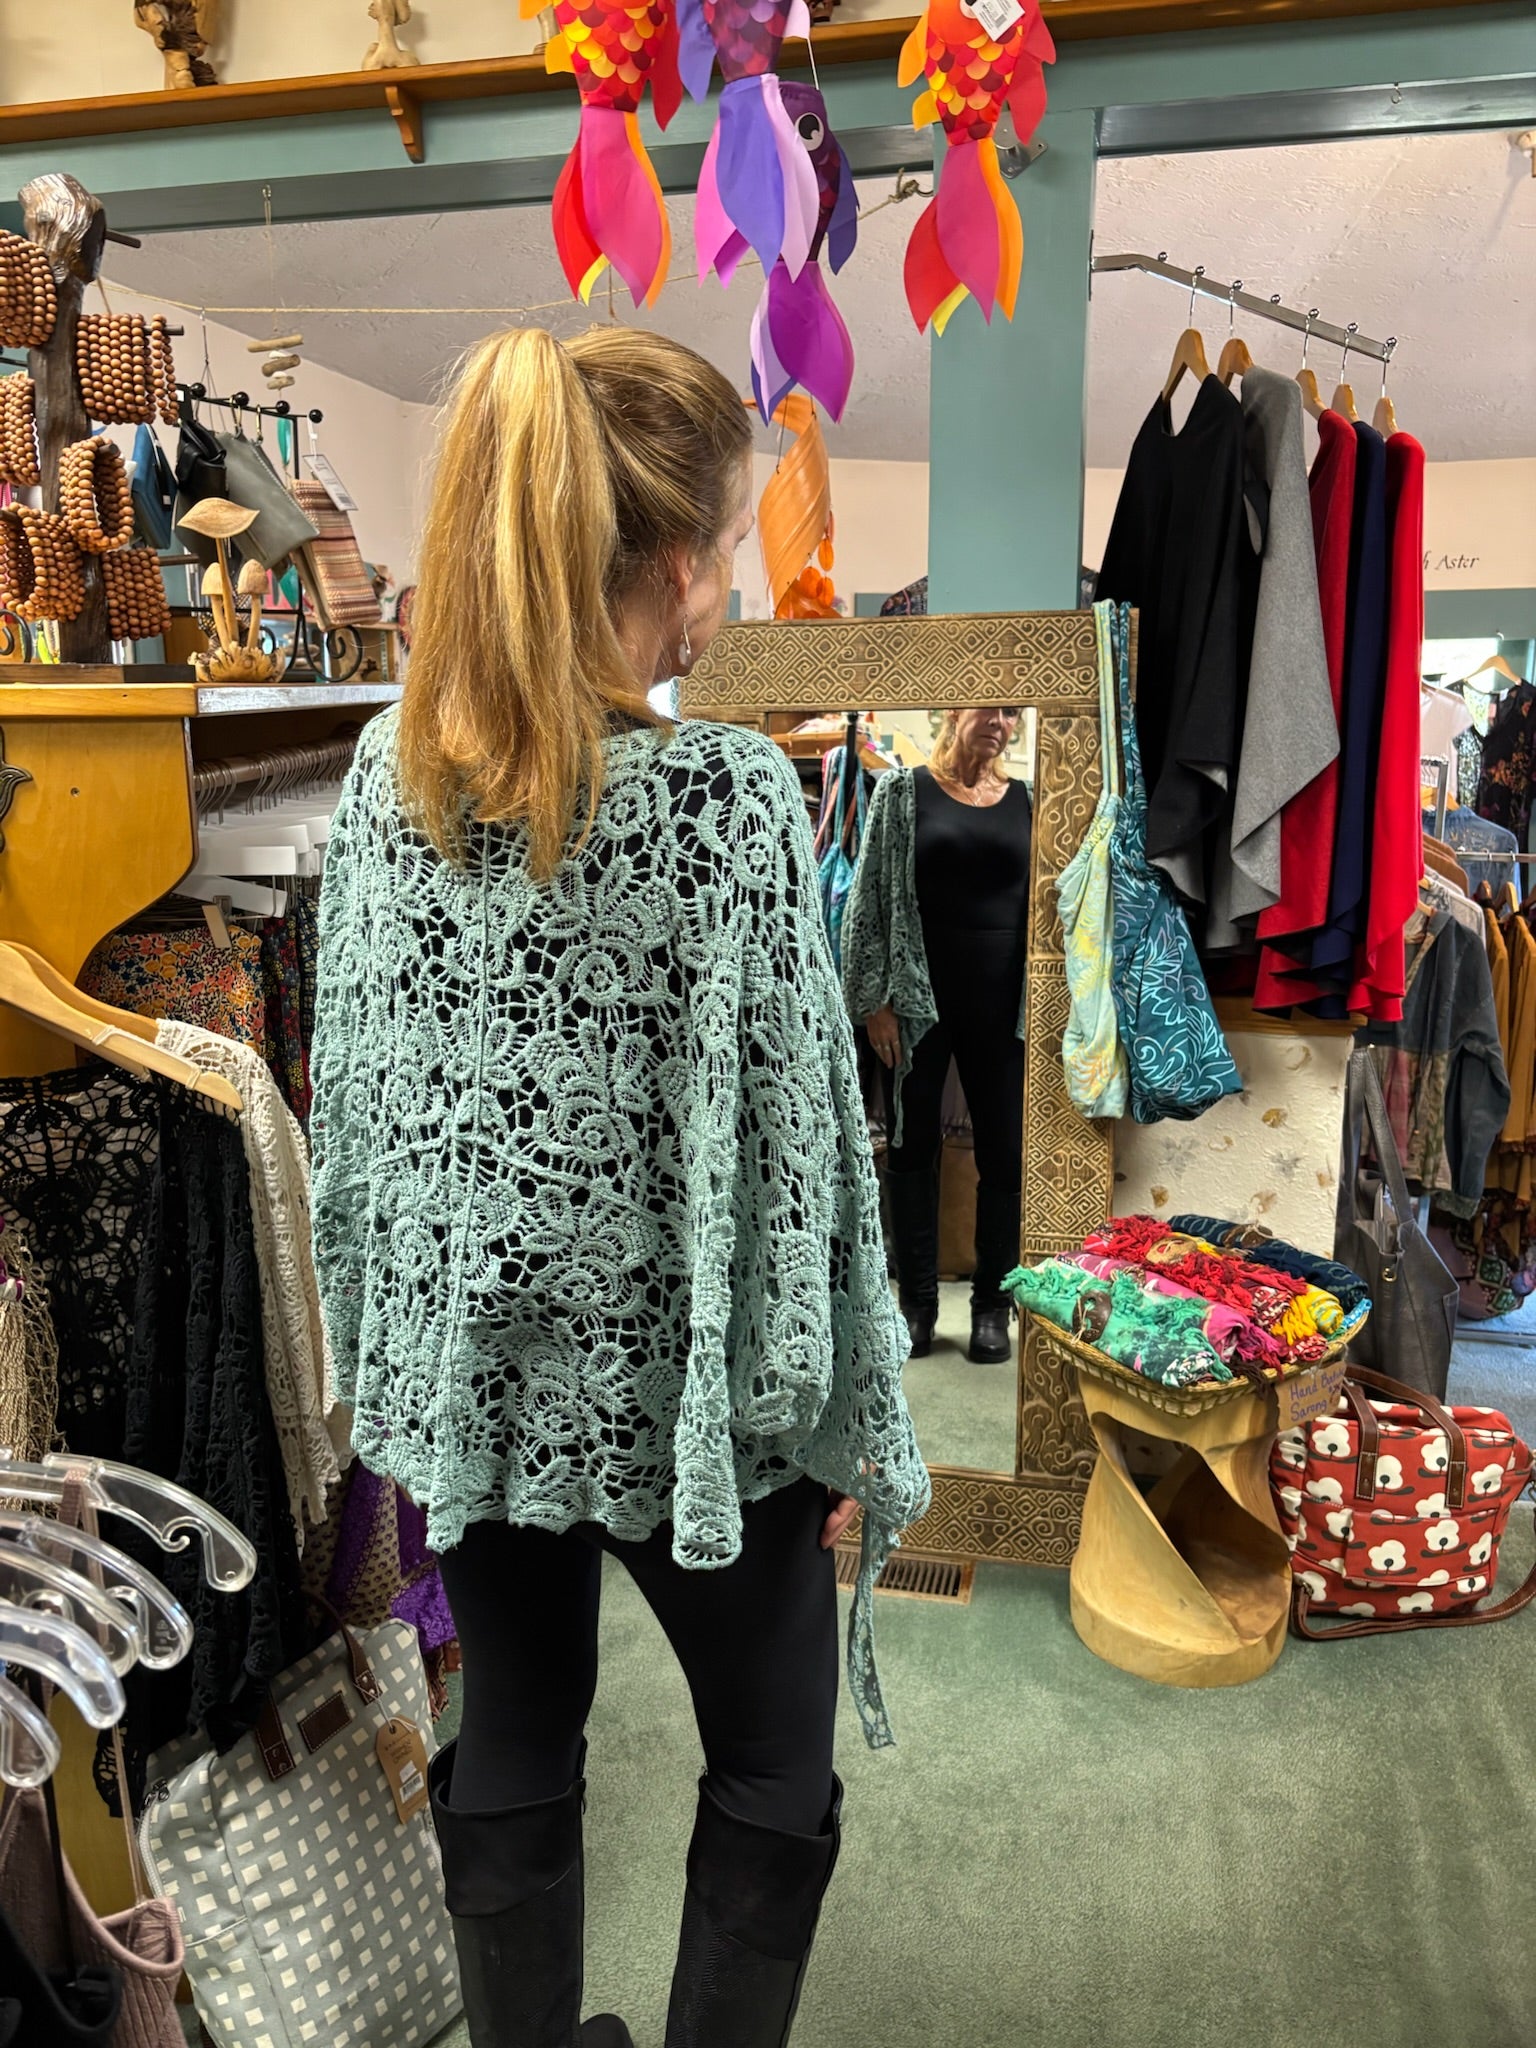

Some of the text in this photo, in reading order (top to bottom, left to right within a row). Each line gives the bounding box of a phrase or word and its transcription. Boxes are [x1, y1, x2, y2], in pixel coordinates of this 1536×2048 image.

[1434, 554, 1480, 571] Aster
[1290, 1377, 1318, 1401] Hand
[1290, 1400, 1327, 1421] Sarong
